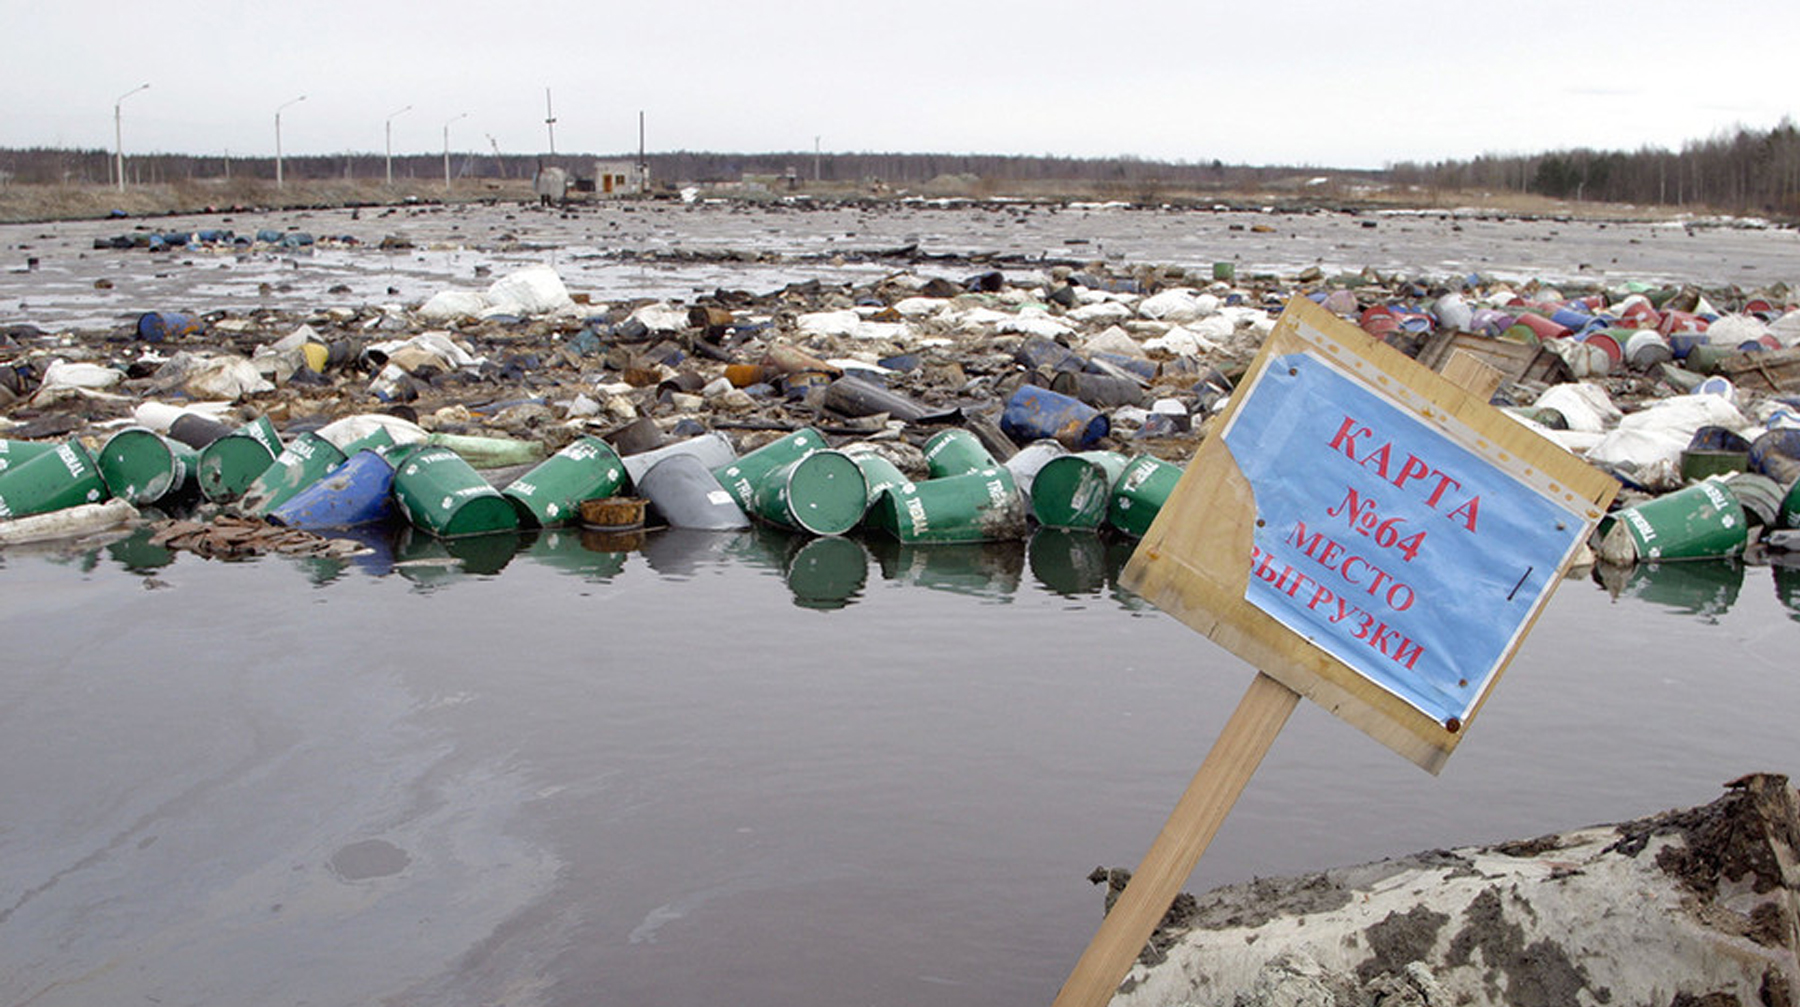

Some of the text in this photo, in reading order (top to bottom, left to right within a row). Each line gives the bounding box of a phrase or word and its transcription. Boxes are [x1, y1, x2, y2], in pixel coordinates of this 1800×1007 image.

[1327, 415, 1480, 533] КАРТА
[1286, 521, 1415, 612] МЕСТО
[1327, 486, 1427, 562] №64
